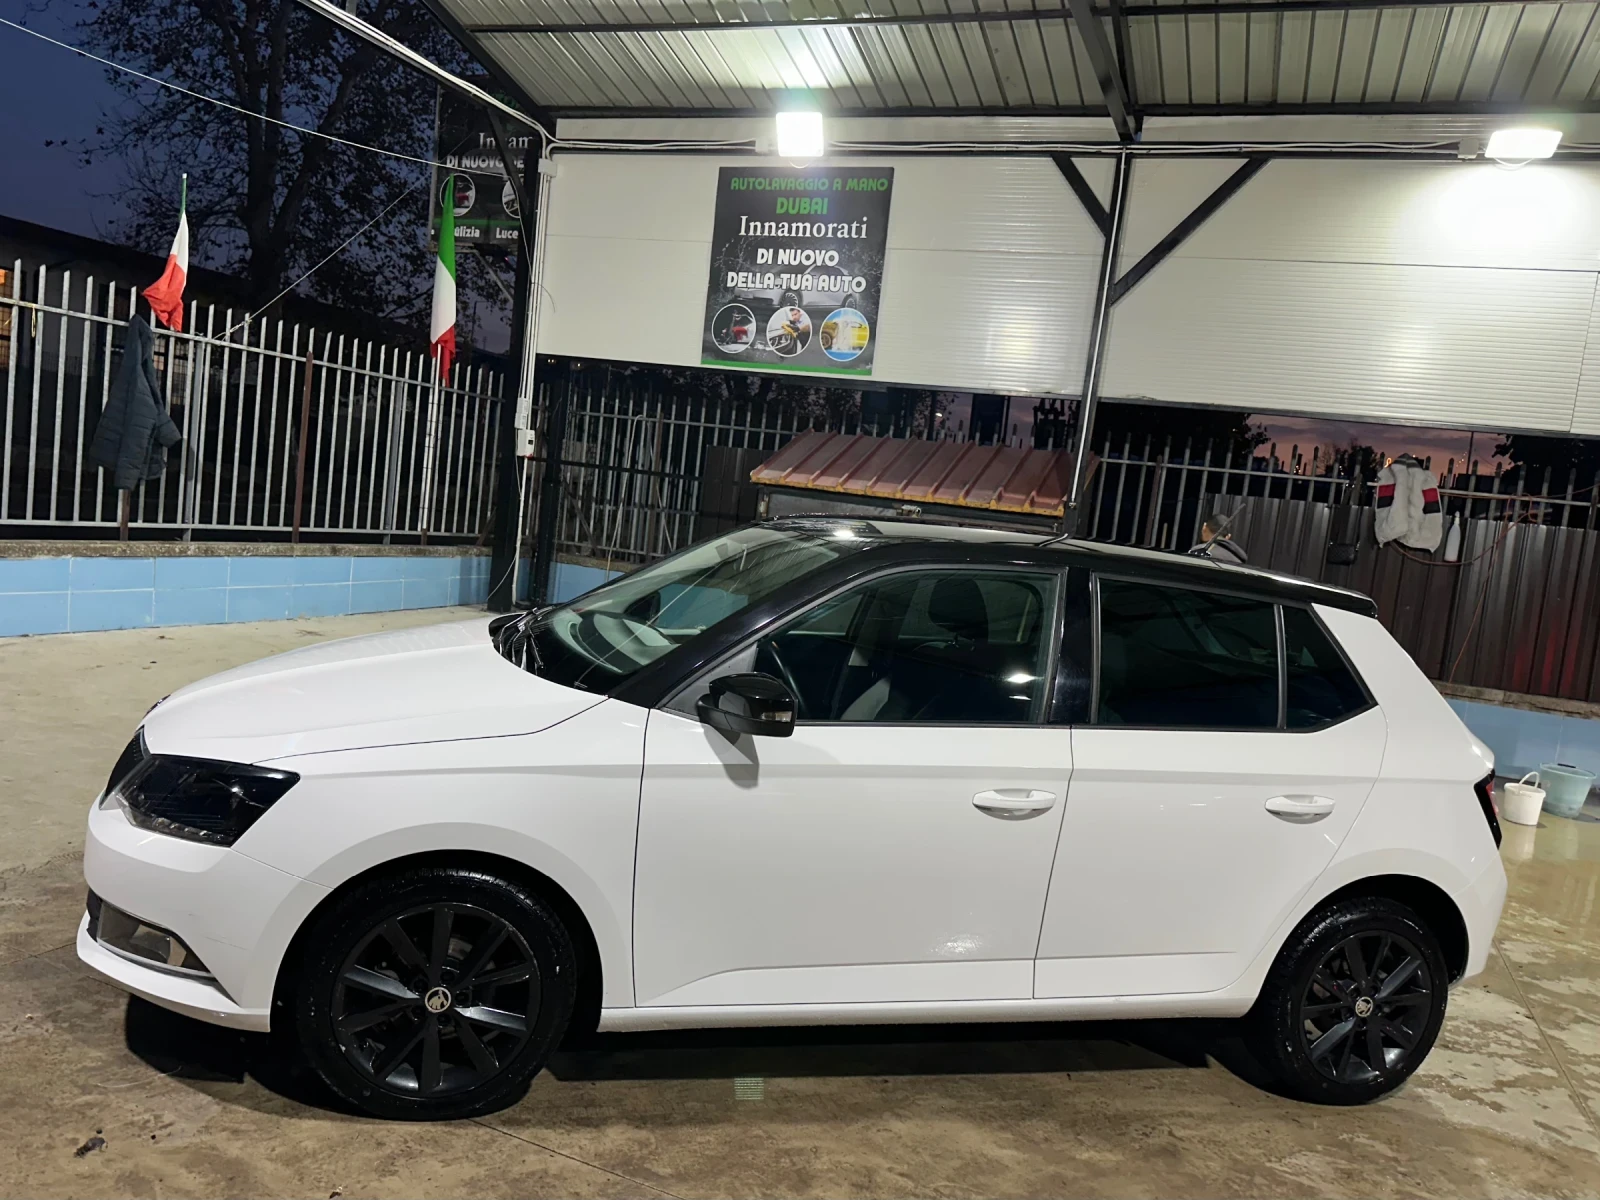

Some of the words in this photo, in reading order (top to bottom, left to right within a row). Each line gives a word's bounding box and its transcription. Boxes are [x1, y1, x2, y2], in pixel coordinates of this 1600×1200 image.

[446, 155, 459, 167] DI
[730, 177, 829, 191] AUTOLAVAGGIO
[833, 178, 842, 190] A
[846, 178, 889, 191] MANO
[776, 197, 828, 215] DUBAI
[454, 226, 480, 238] ulizia
[495, 227, 519, 239] Luce
[738, 215, 868, 239] Innamorati
[756, 248, 774, 265] DI
[777, 249, 840, 267] NUOVO
[726, 271, 775, 290] DELLA
[780, 273, 813, 291] TUA
[817, 275, 867, 293] AUTO
